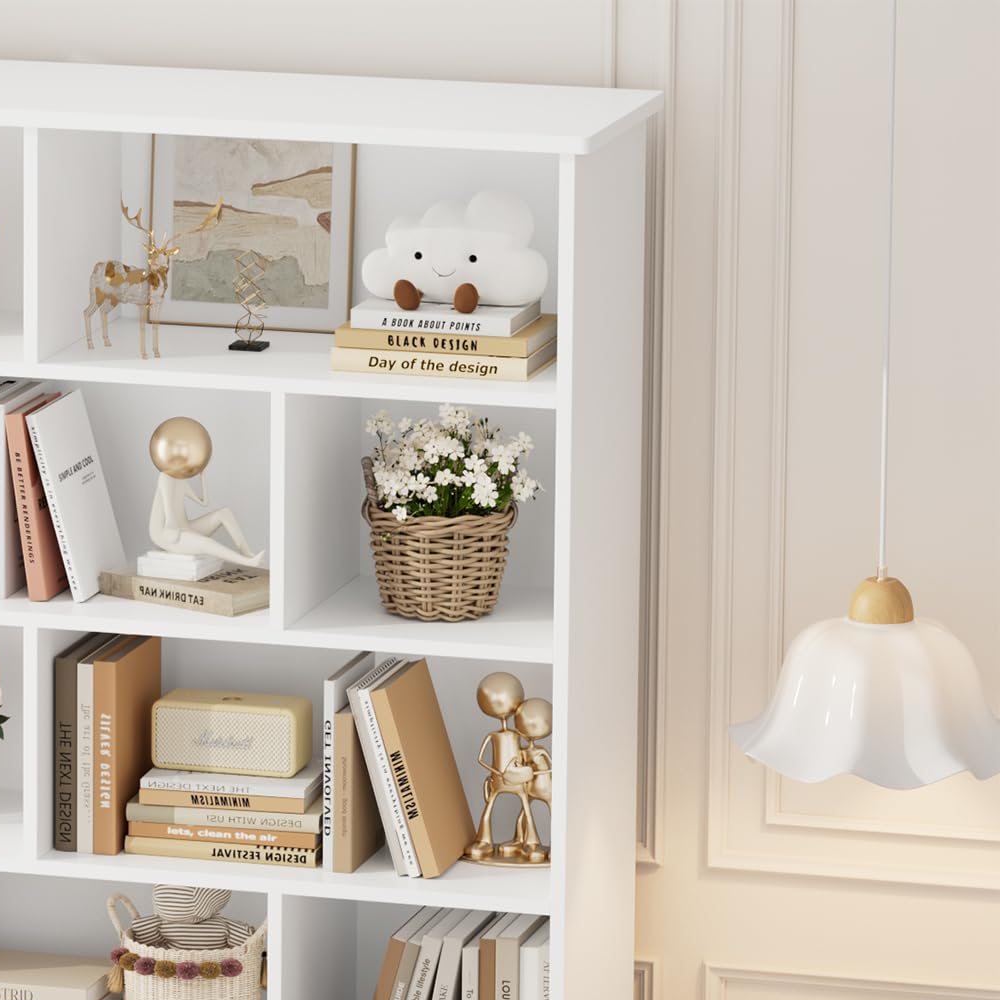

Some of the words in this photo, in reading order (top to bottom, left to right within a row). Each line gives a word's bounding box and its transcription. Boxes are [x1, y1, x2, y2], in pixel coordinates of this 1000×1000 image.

[382, 317, 388, 327] A
[391, 318, 414, 328] BOOK
[417, 319, 446, 330] ABOUT
[449, 321, 481, 332] POINTS
[387, 335, 426, 347] BLACK
[433, 338, 478, 351] DESIGN
[368, 356, 396, 370] Day
[401, 358, 417, 370] of
[420, 360, 444, 371] the
[449, 362, 498, 376] design
[15, 452, 22, 463] BE
[17, 467, 27, 500] BETTER
[22, 503, 35, 564] RENDERINGS
[197, 828, 232, 839] clean
[234, 830, 256, 841] the
[257, 833, 278, 842] air
[415, 957, 432, 989] lifestyle
[466, 989, 474, 998] To
